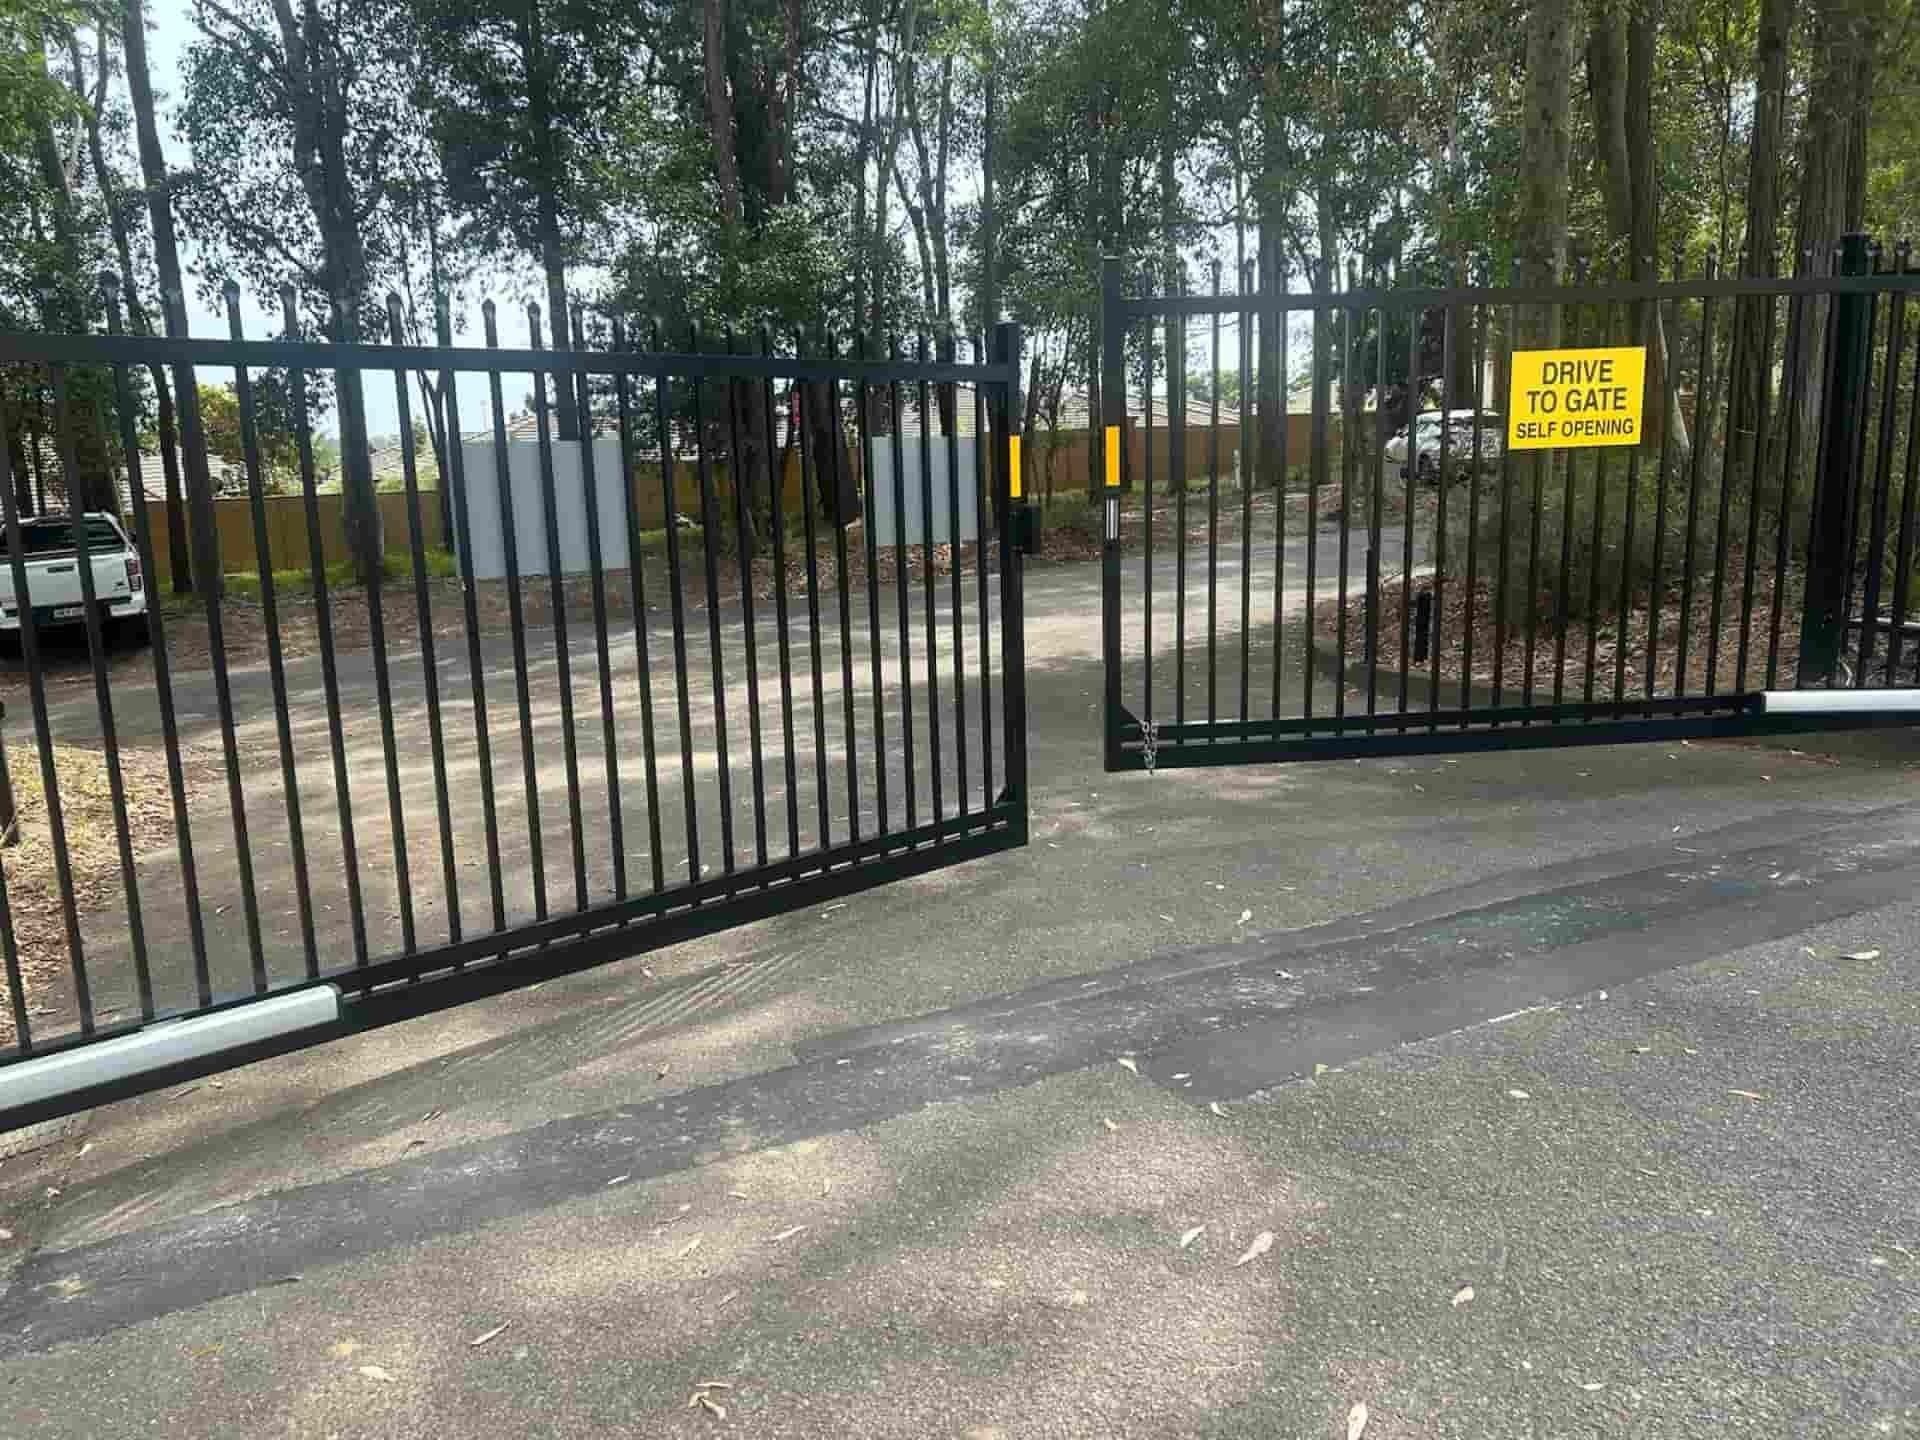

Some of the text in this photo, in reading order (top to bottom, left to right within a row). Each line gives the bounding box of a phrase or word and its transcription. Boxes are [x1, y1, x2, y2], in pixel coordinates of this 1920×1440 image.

[1542, 359, 1614, 385] DRIVE
[1526, 387, 1628, 414] TO GATE
[1516, 418, 1634, 439] SELF OPENING
